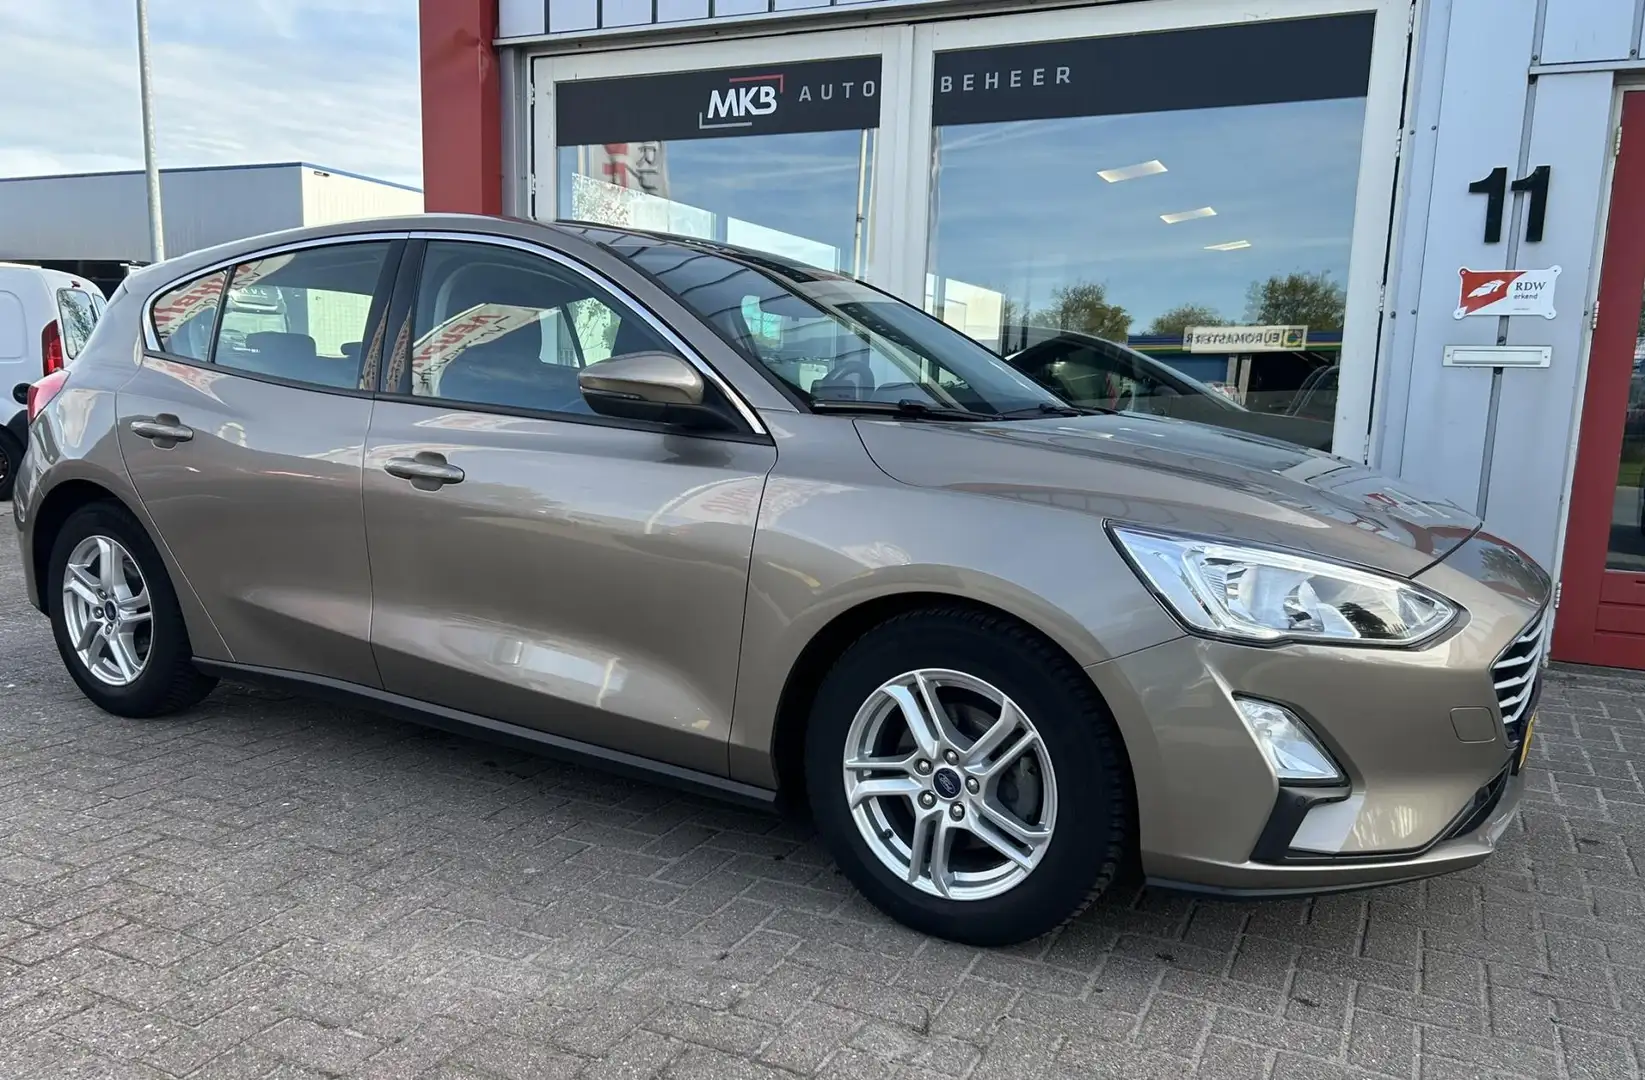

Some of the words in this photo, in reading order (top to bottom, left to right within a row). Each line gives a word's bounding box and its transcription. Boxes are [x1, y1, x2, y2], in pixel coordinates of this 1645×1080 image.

[707, 85, 777, 119] MKB
[798, 80, 876, 102] AUTO
[940, 66, 1072, 93] BEHEER
[1468, 165, 1551, 243] 11
[1515, 281, 1547, 291] RDW
